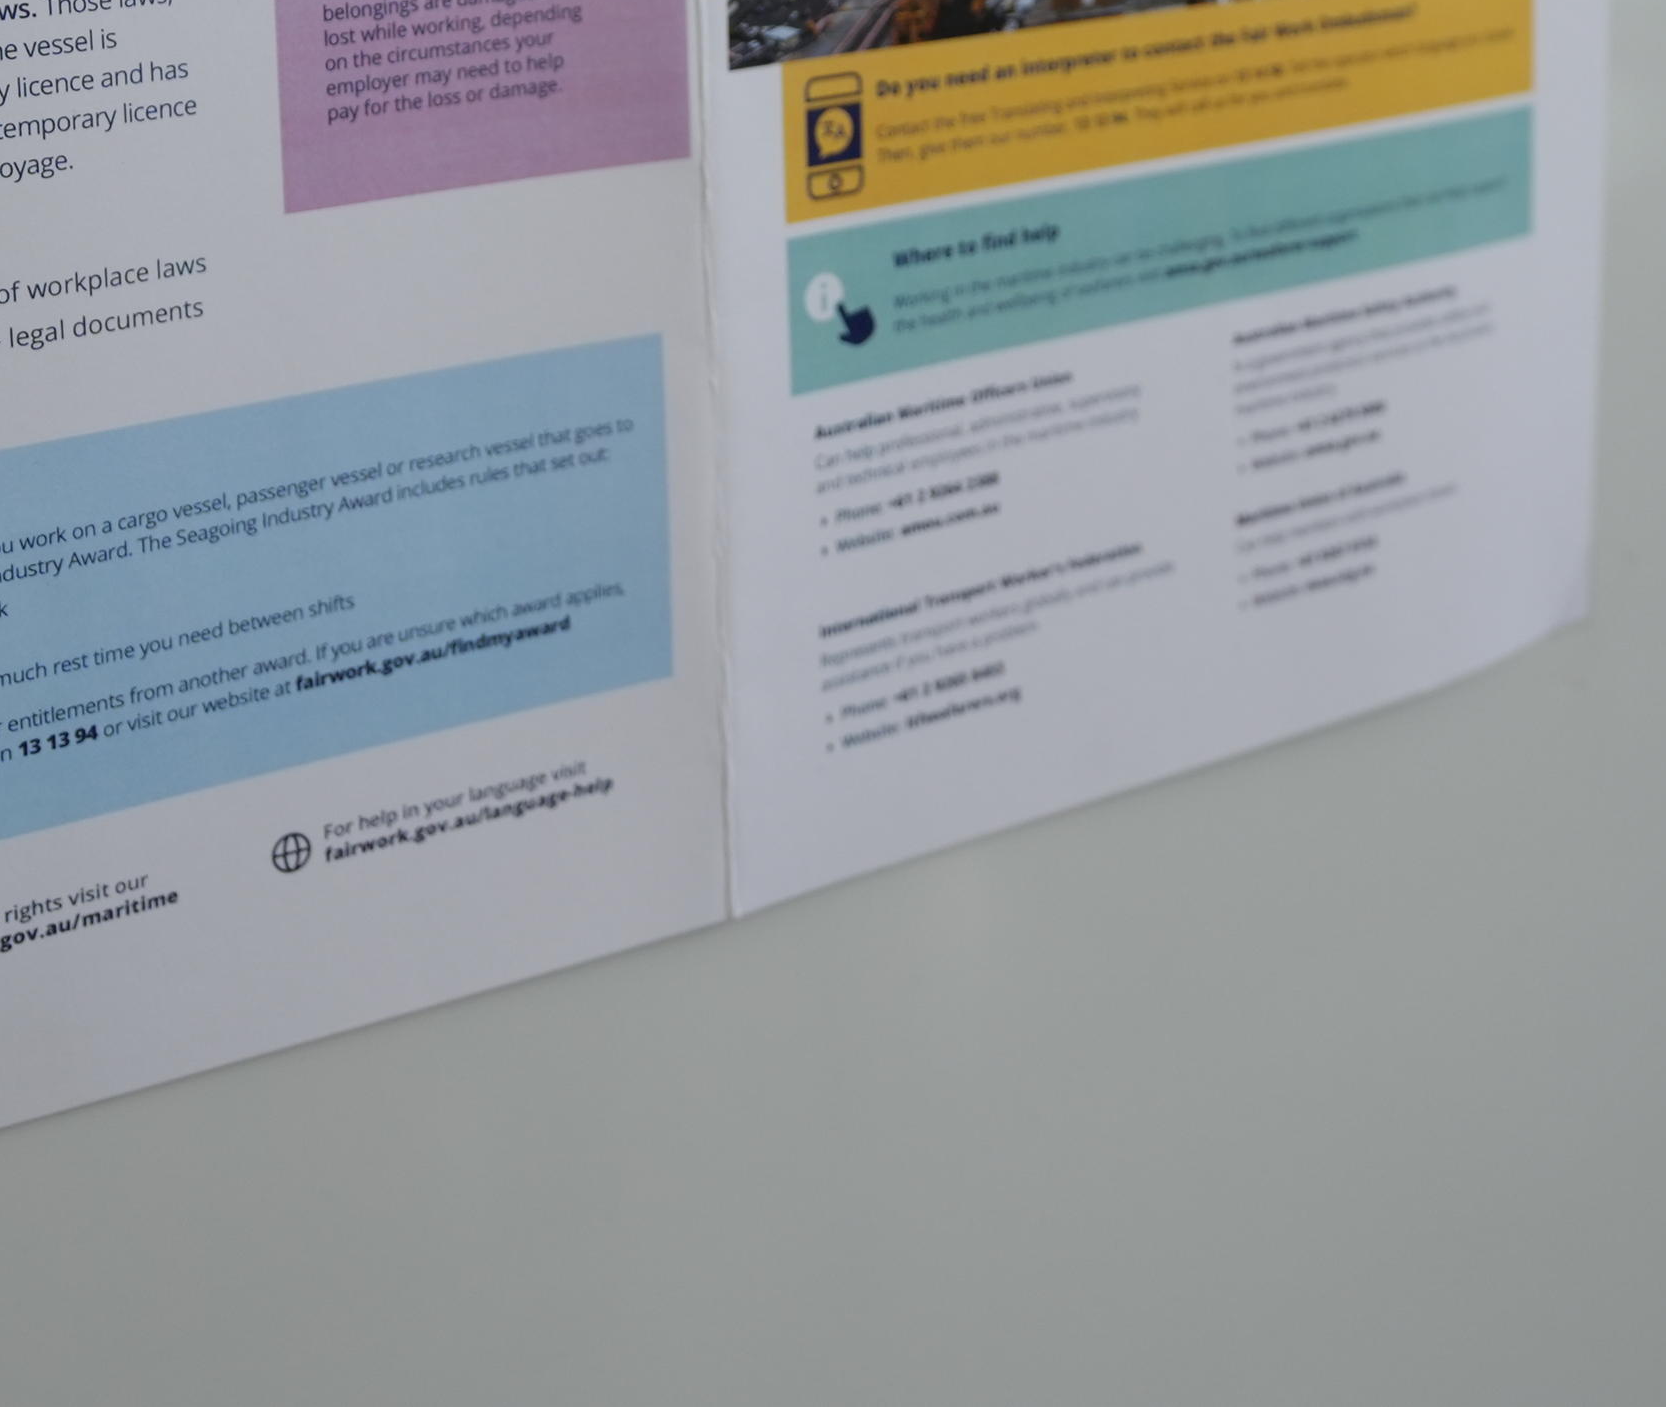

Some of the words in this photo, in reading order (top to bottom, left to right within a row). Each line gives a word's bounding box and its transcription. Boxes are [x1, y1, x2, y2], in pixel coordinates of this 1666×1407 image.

[27, 266, 148, 300] workplace
[157, 257, 206, 279] laws
[5, 897, 62, 924] rights
[69, 884, 108, 906] visit
[115, 875, 147, 894] our
